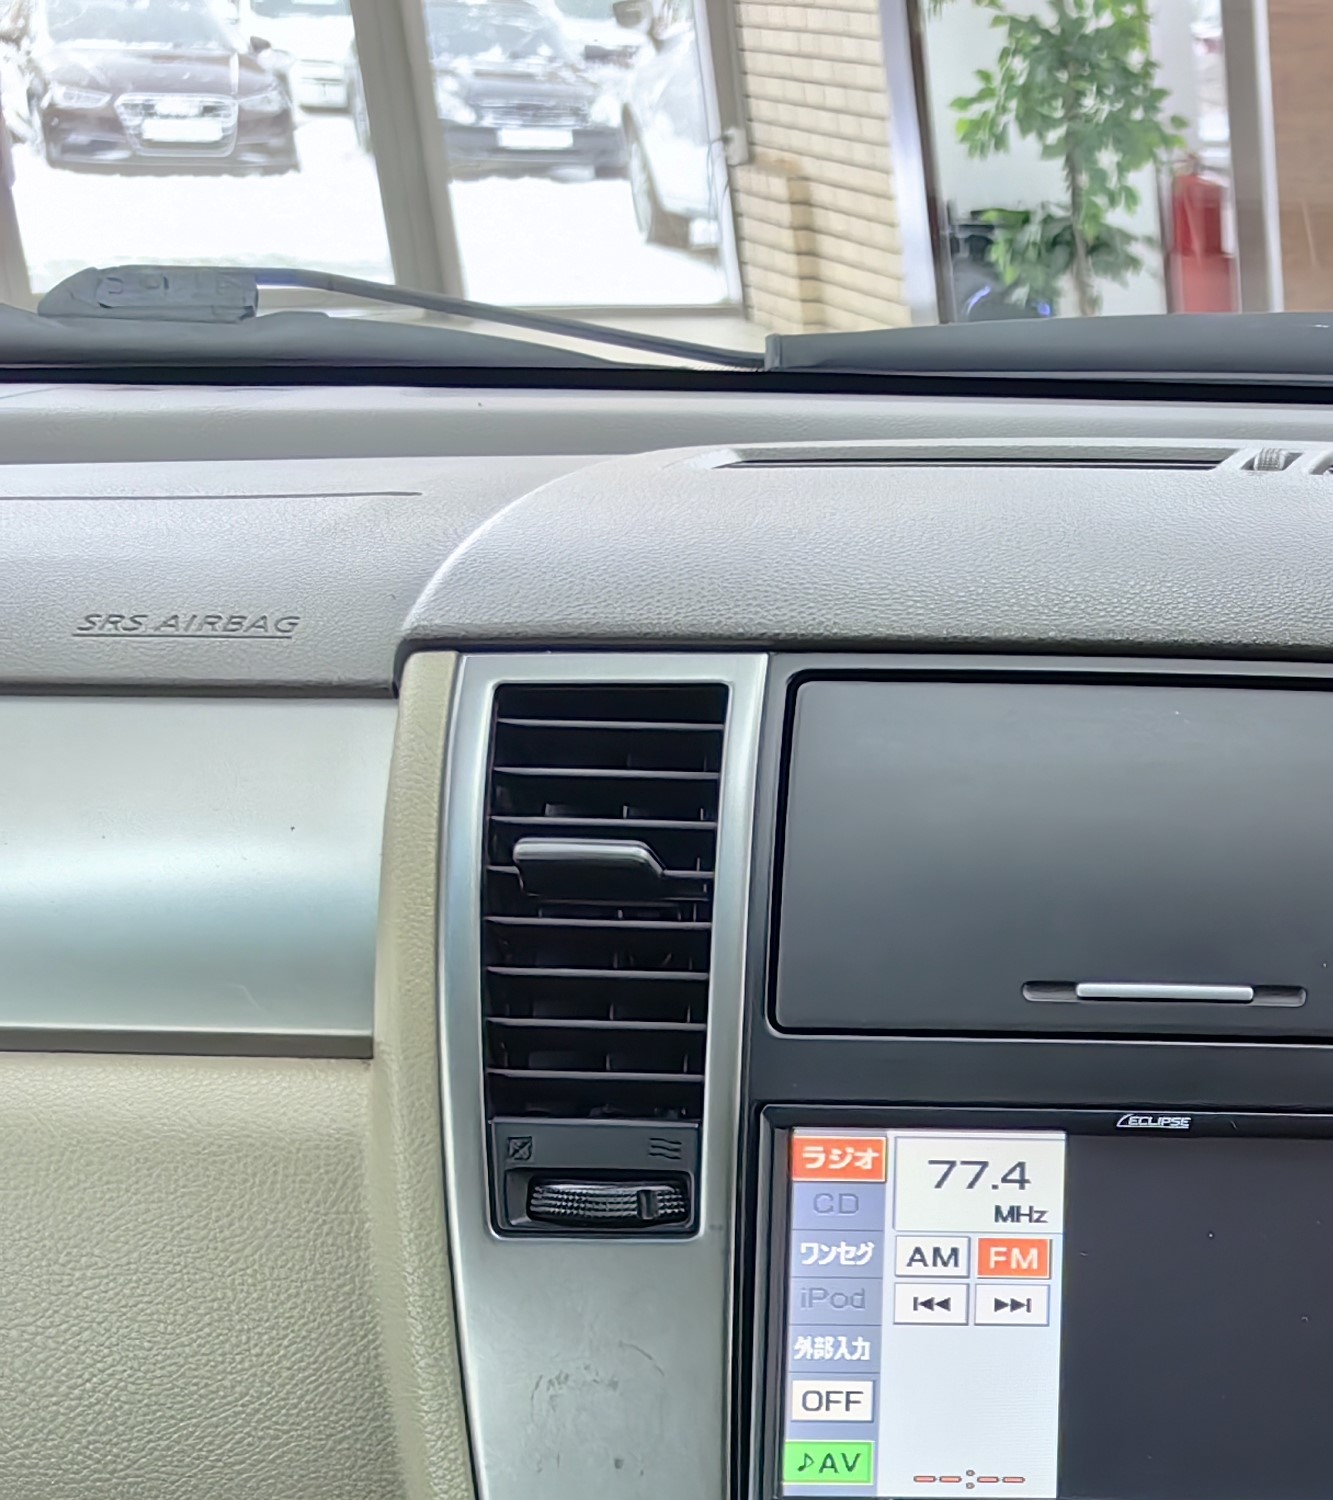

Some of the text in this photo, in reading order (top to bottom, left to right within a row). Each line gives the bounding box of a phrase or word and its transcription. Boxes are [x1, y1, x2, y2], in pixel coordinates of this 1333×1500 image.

[77, 613, 300, 634] SRS AIRBAG
[1117, 1113, 1192, 1130] ECLIPSE
[802, 1146, 879, 1170] ラジオ
[928, 1159, 1031, 1191] 77.4
[812, 1192, 860, 1215] CD
[993, 1204, 1048, 1224] MHz
[800, 1241, 875, 1267] ワンセグ
[906, 1246, 960, 1268] AM
[989, 1246, 1039, 1270] FM
[800, 1287, 866, 1311] iPod
[793, 1335, 871, 1361] 外部入力
[801, 1389, 865, 1413] OFF
[818, 1452, 862, 1475] AV
